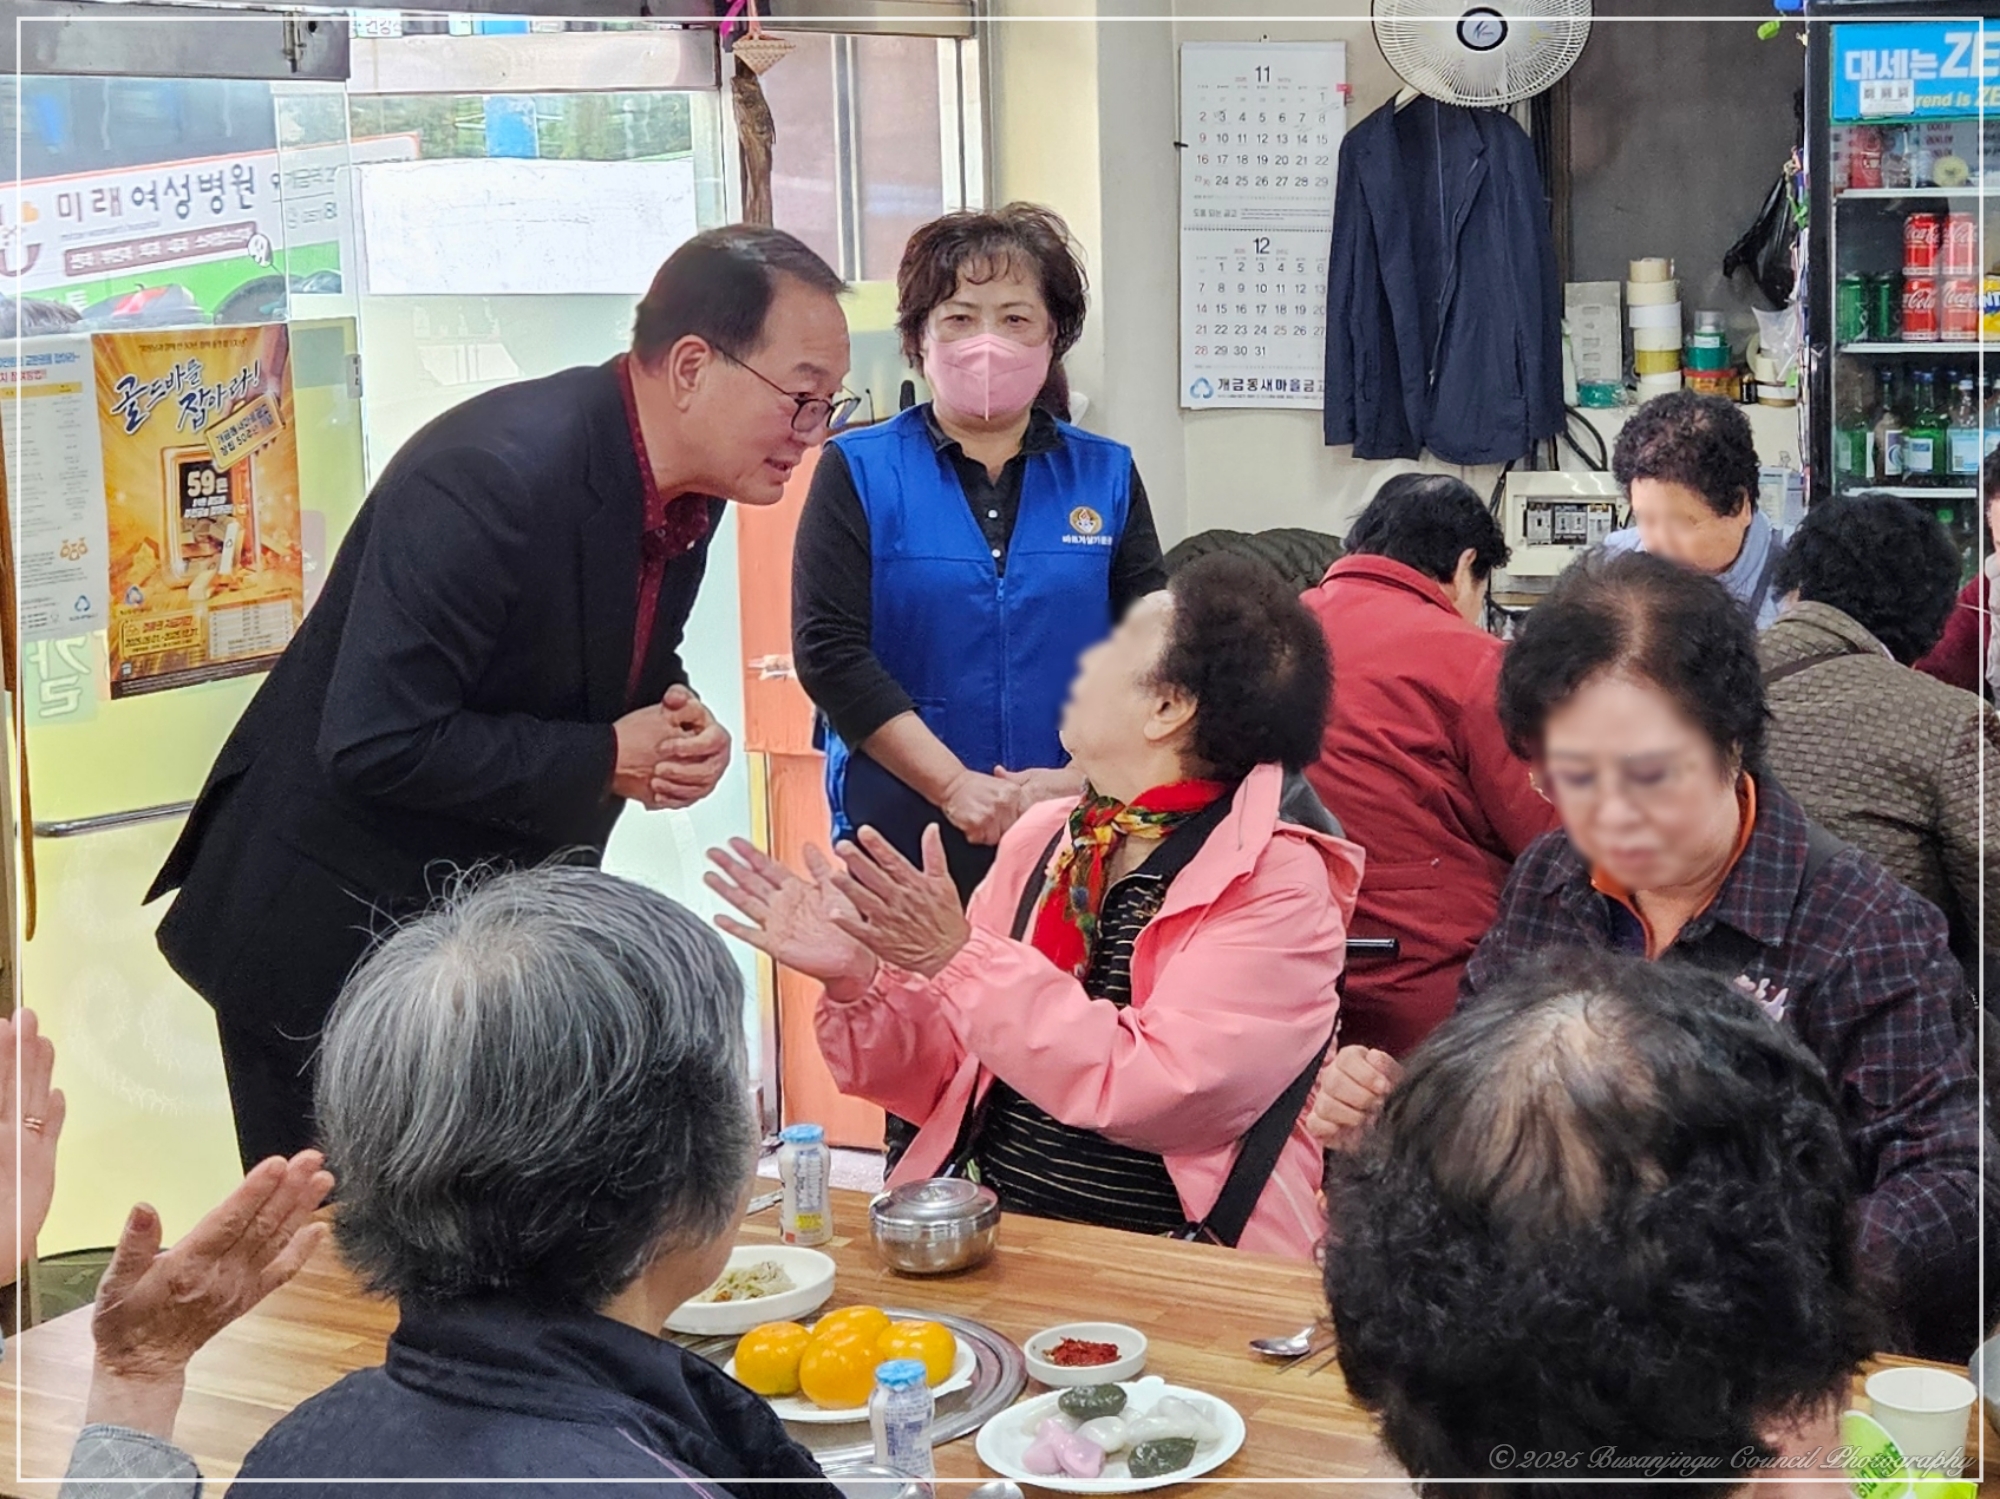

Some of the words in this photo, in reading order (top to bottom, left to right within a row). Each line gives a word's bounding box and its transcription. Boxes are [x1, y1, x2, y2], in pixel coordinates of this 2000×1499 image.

[1846, 49, 1938, 80] 대세는
[1939, 31, 2000, 78] ZE
[1255, 65, 1270, 83] 11
[1915, 94, 1952, 108] rend
[1199, 111, 1207, 122] 2
[1219, 111, 1226, 122] 3
[1238, 112, 1246, 123] 4
[1259, 112, 1266, 123] 5
[1279, 112, 1286, 123] 6
[1299, 112, 1306, 123] 7
[1319, 113, 1326, 124] 8
[1199, 133, 1207, 143] 9
[1217, 133, 1229, 143] 10
[1237, 134, 1247, 144] 11
[1257, 134, 1269, 144] 12
[1277, 134, 1288, 144] 13
[1297, 134, 1308, 144] 14
[1317, 134, 1328, 144] 15
[1196, 154, 1209, 164] 16
[1217, 155, 1228, 165] 17
[1236, 155, 1249, 165] 18
[1257, 155, 1269, 165] 19
[1275, 155, 1289, 165] 20
[1295, 155, 1308, 165] 21
[1315, 156, 1329, 166] 22
[1215, 176, 1229, 186] 24
[1235, 176, 1249, 186] 25
[1255, 176, 1269, 186] 26
[1275, 176, 1289, 186] 27
[1295, 176, 1308, 186] 28
[1315, 177, 1329, 187] 29
[57, 163, 256, 223] 미래여성병원
[1253, 237, 1270, 254] 12
[1219, 262, 1224, 271] 1
[1238, 262, 1245, 271] 2
[1258, 263, 1265, 272] 3
[1278, 263, 1285, 272] 4
[1297, 263, 1304, 272] 5
[1317, 264, 1324, 273] 6
[1199, 282, 1205, 292] 7
[1218, 283, 1225, 293] 8
[1238, 283, 1245, 293] 9
[1255, 283, 1268, 293] 10
[1276, 284, 1286, 294] 11
[1295, 284, 1307, 294] 12
[1314, 285, 1326, 295] 13
[1196, 304, 1207, 313] 14
[1216, 304, 1227, 313] 15
[1235, 305, 1247, 314] 16
[1256, 305, 1267, 314] 17
[1275, 305, 1287, 314] 18
[1295, 305, 1306, 314] 19
[1313, 306, 1325, 315] 20
[1195, 324, 1207, 334] 21
[1214, 324, 1228, 334] 22
[1234, 324, 1247, 334] 23
[1254, 325, 1267, 335] 24
[1274, 325, 1287, 335] 25
[1293, 325, 1307, 335] 26
[1313, 326, 1325, 336] 27
[1194, 345, 1208, 355] 28
[1214, 345, 1228, 355] 29
[1233, 345, 1247, 355] 30
[1255, 346, 1266, 356] 31
[112, 359, 201, 432] 골드바를
[178, 360, 260, 430] 잡아라!
